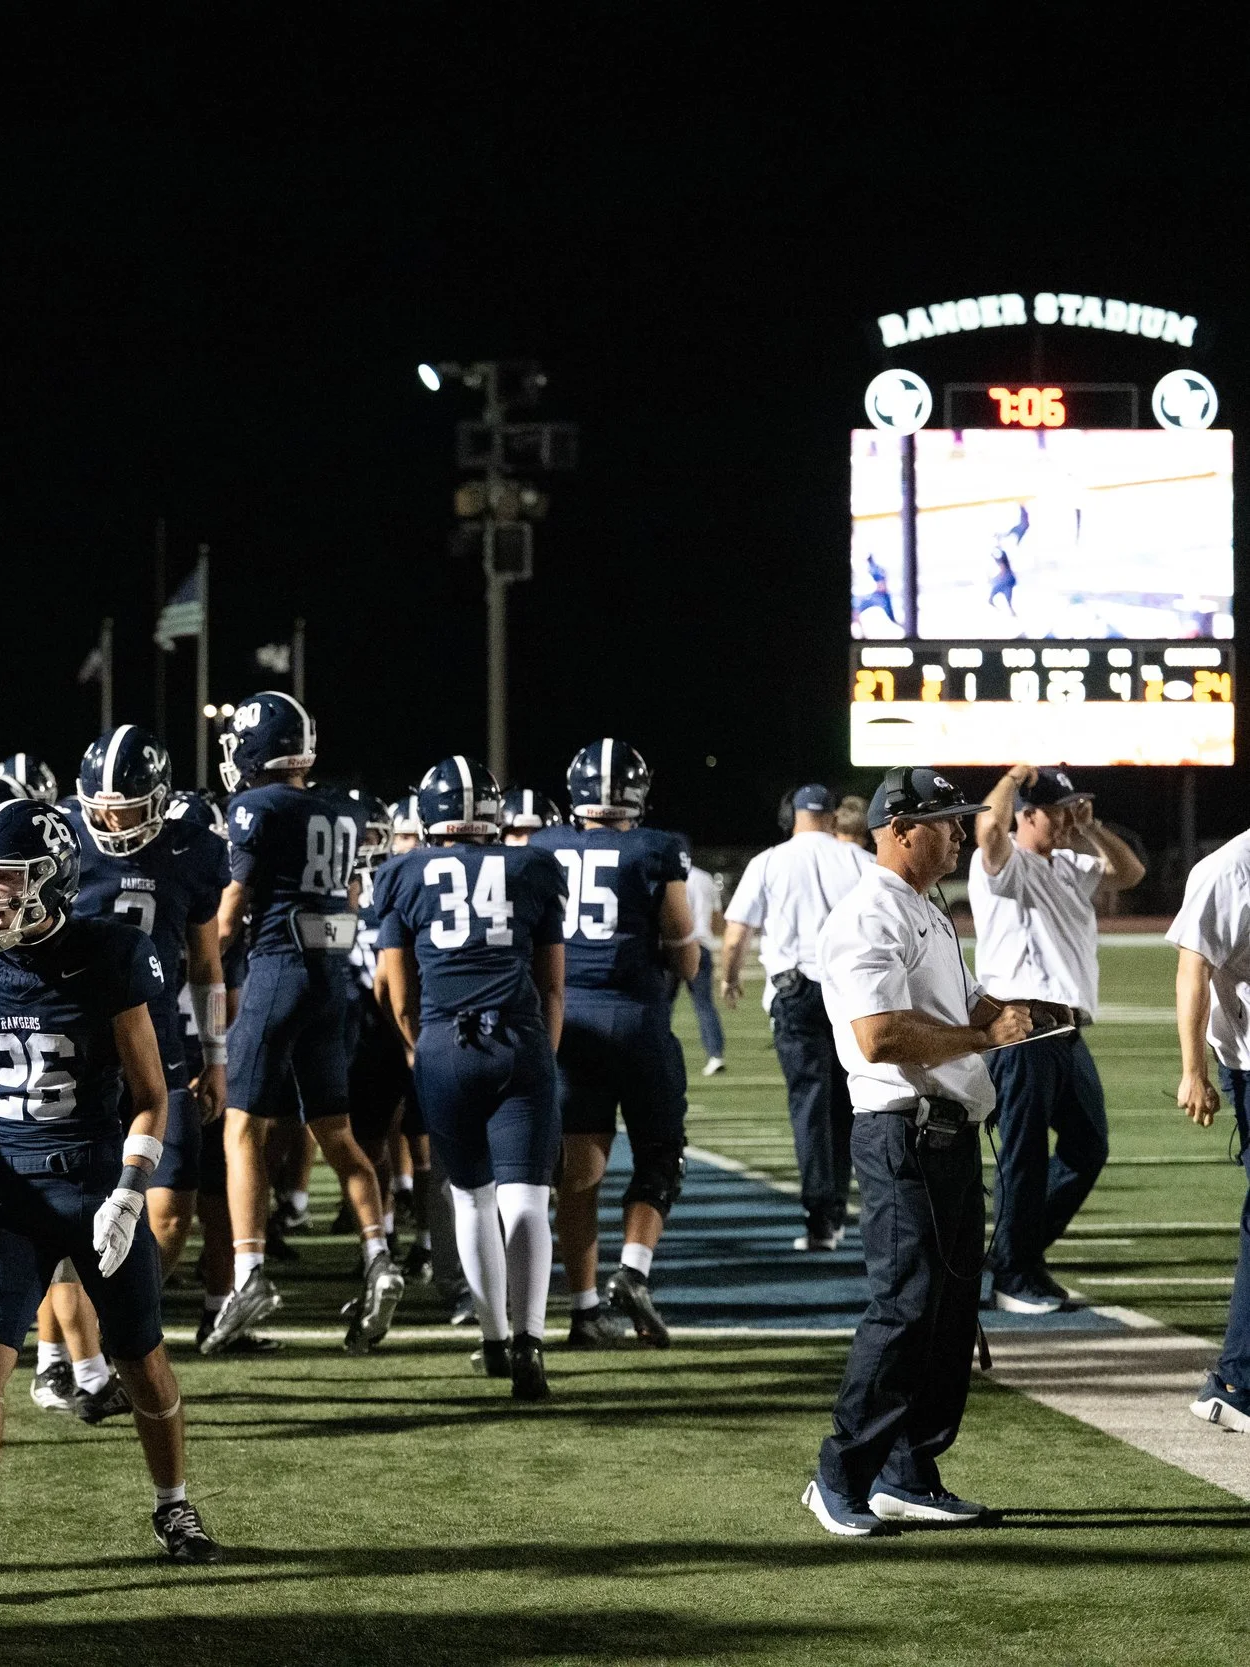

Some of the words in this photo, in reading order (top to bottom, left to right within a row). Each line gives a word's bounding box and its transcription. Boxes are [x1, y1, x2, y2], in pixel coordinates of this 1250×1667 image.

[878, 293, 1027, 348] RANGER
[1034, 292, 1198, 347] STADIUM
[988, 387, 1066, 427] 7:06
[854, 670, 895, 702] 27
[1109, 672, 1132, 702] 4
[1193, 670, 1231, 702] 24
[233, 702, 261, 732] 80
[32, 812, 72, 849] 26
[446, 824, 488, 835] Riddell
[300, 815, 358, 898] 80
[121, 876, 156, 891] RANGERS
[423, 855, 513, 949] 34
[0, 1016, 41, 1030] RANGERS
